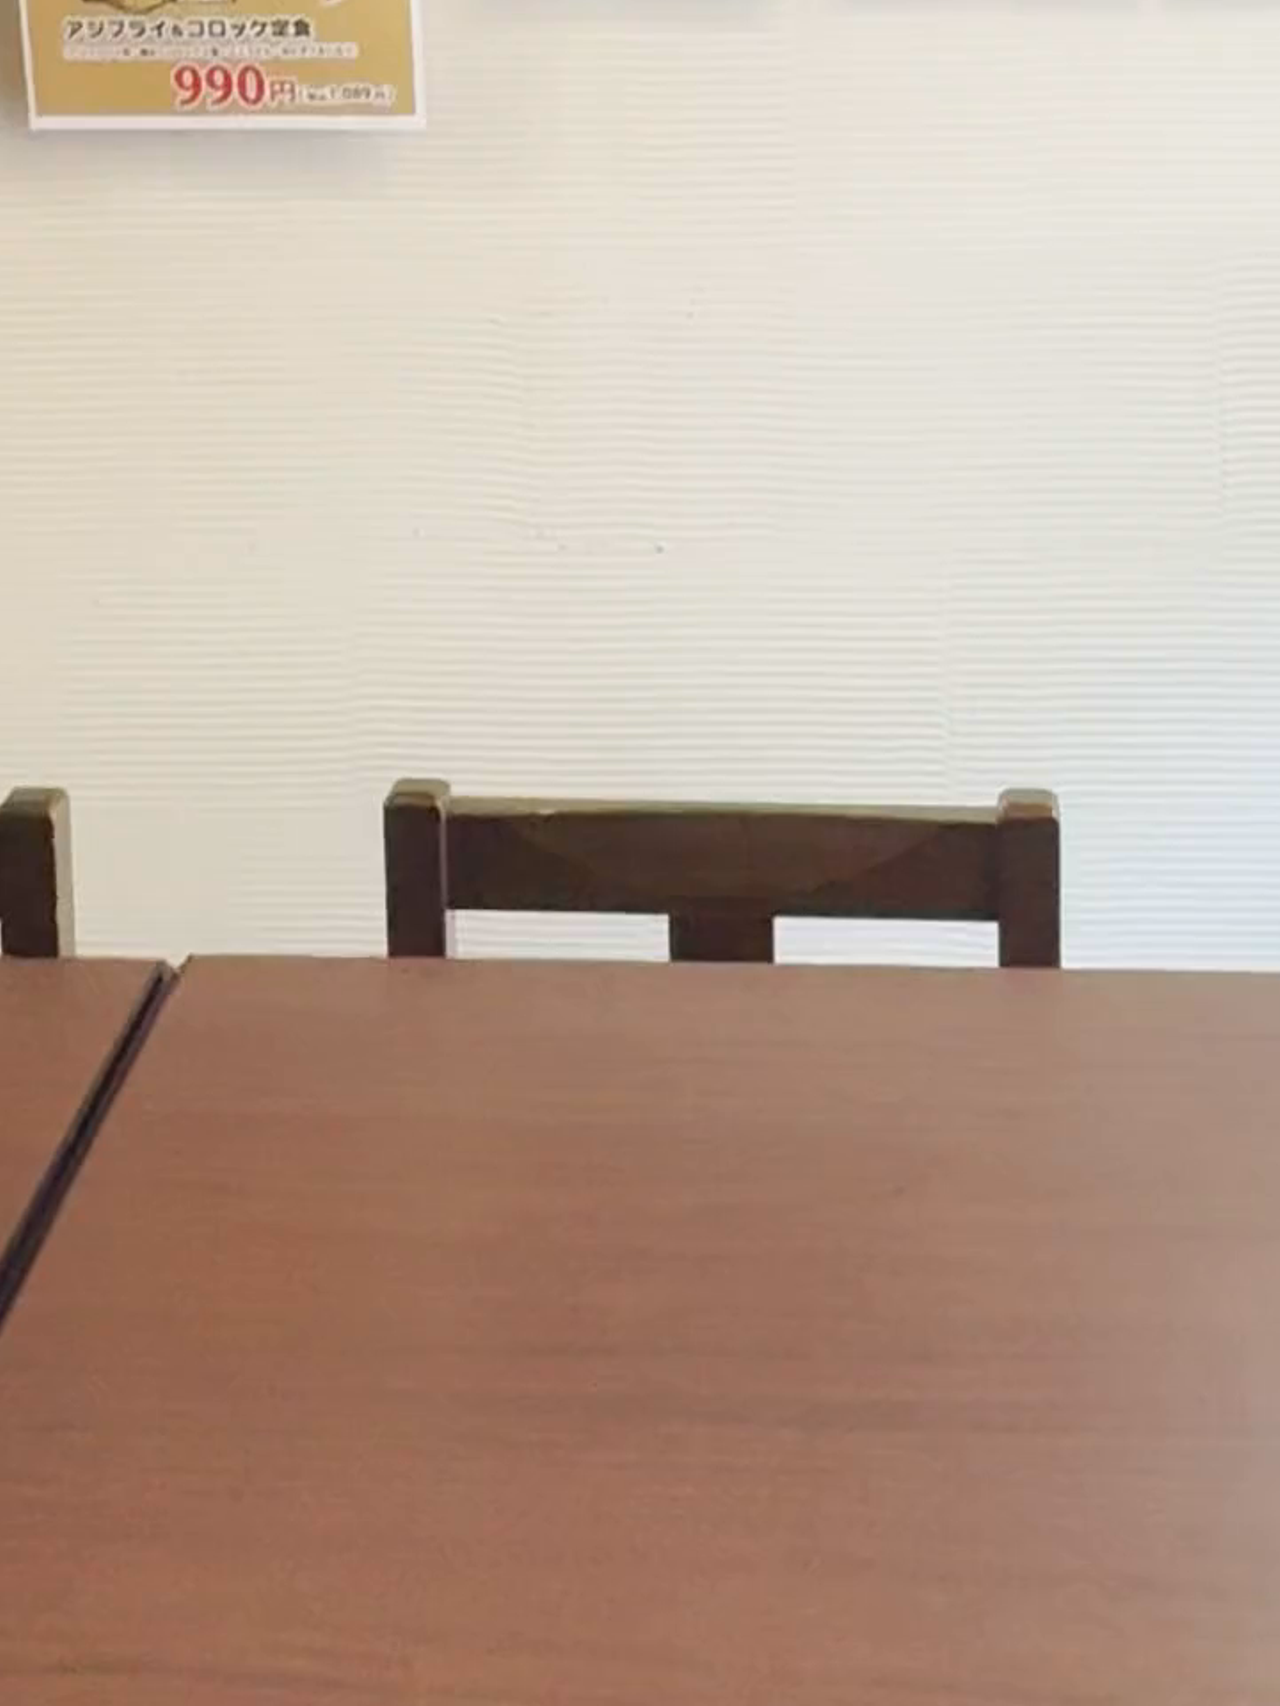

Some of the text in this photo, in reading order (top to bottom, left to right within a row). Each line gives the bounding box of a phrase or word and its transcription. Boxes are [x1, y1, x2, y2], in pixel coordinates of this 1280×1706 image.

[65, 18, 312, 40] アジフライ&コロッケ定食
[173, 63, 296, 107] 990円
